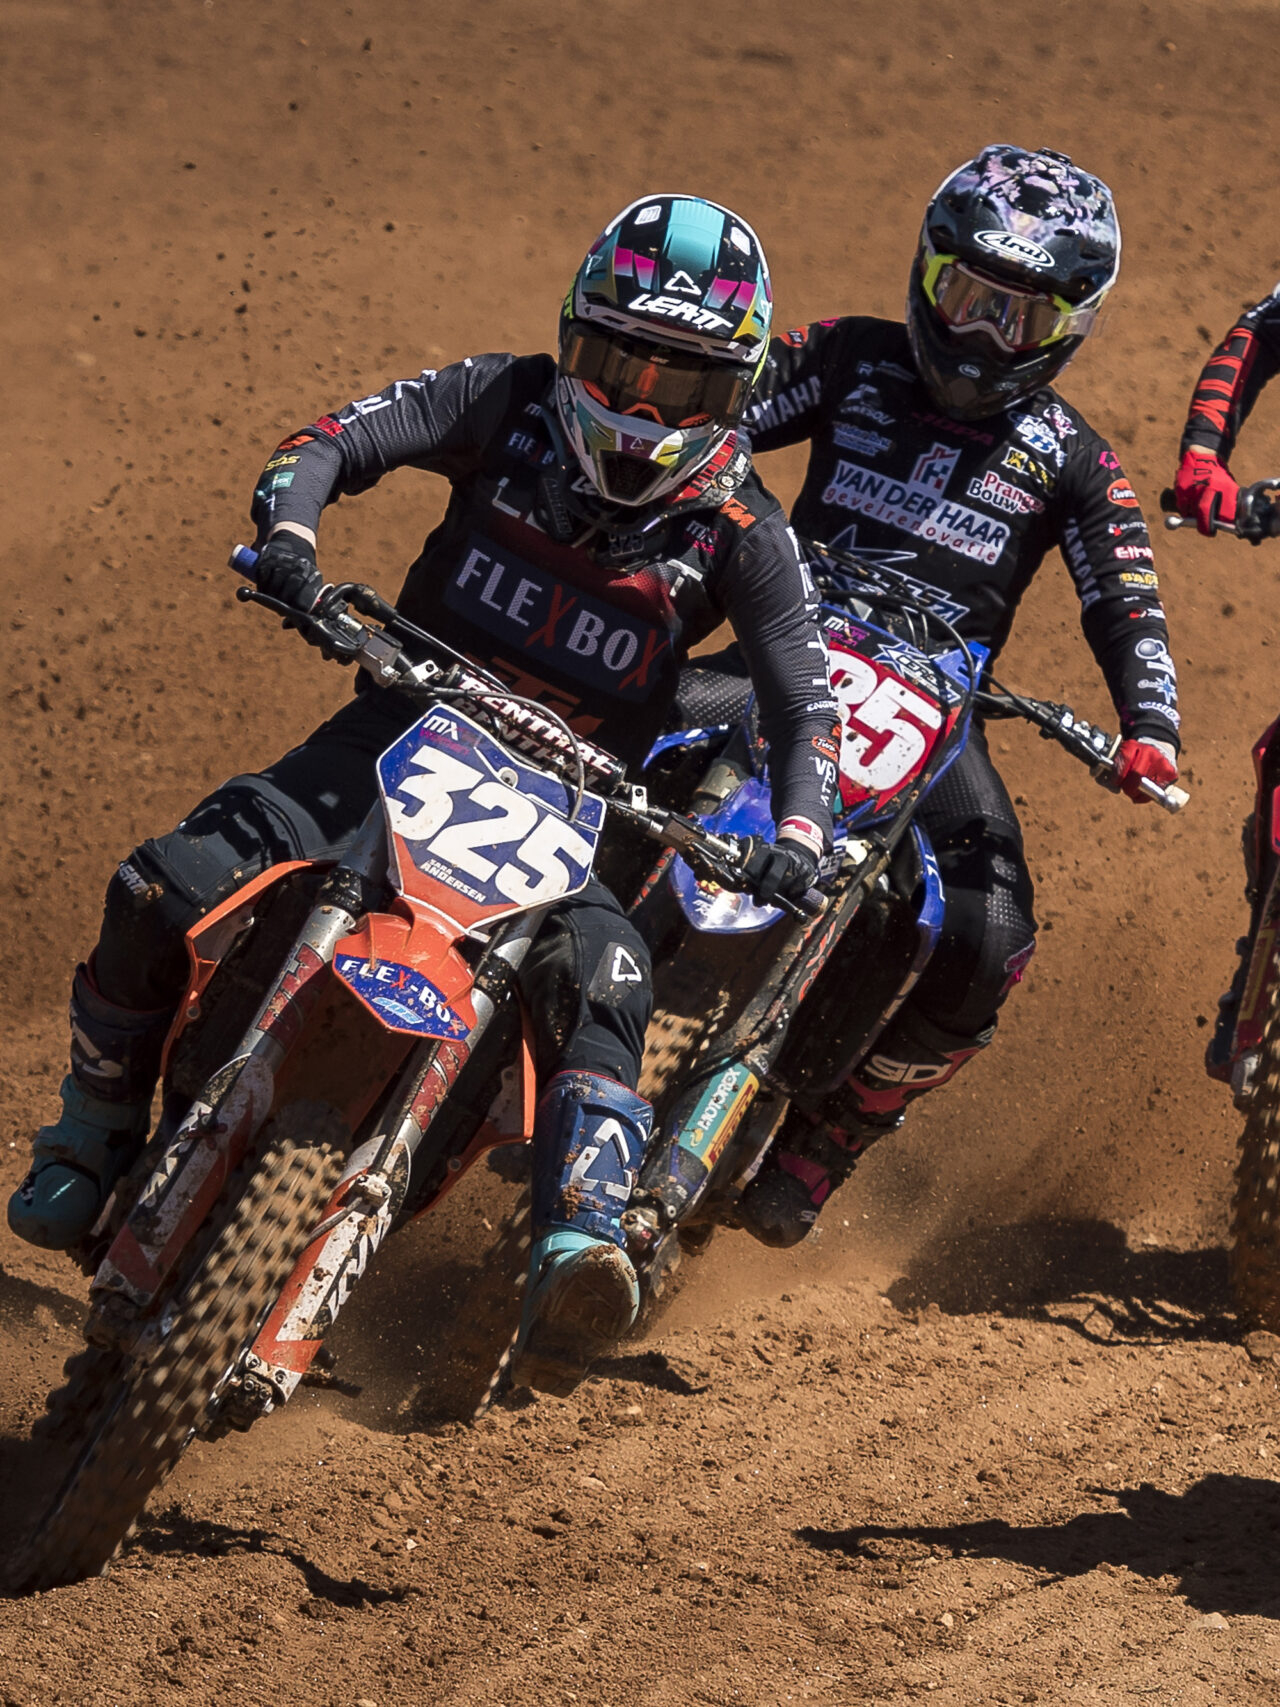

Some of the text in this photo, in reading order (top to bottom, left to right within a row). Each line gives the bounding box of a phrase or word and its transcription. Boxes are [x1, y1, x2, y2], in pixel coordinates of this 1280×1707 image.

[992, 235, 1043, 260] Arai
[628, 293, 735, 331] LEATT
[825, 486, 998, 563] gevelrenovatie
[837, 464, 1007, 547] VAN DER HAAR
[970, 480, 1020, 513] Bouw
[455, 548, 671, 691] FLEXBOX
[384, 744, 595, 907] 325
[419, 861, 487, 903] ANDERSEN
[341, 958, 467, 1037] FLEX-BOX
[697, 1067, 742, 1131] MOTOREX
